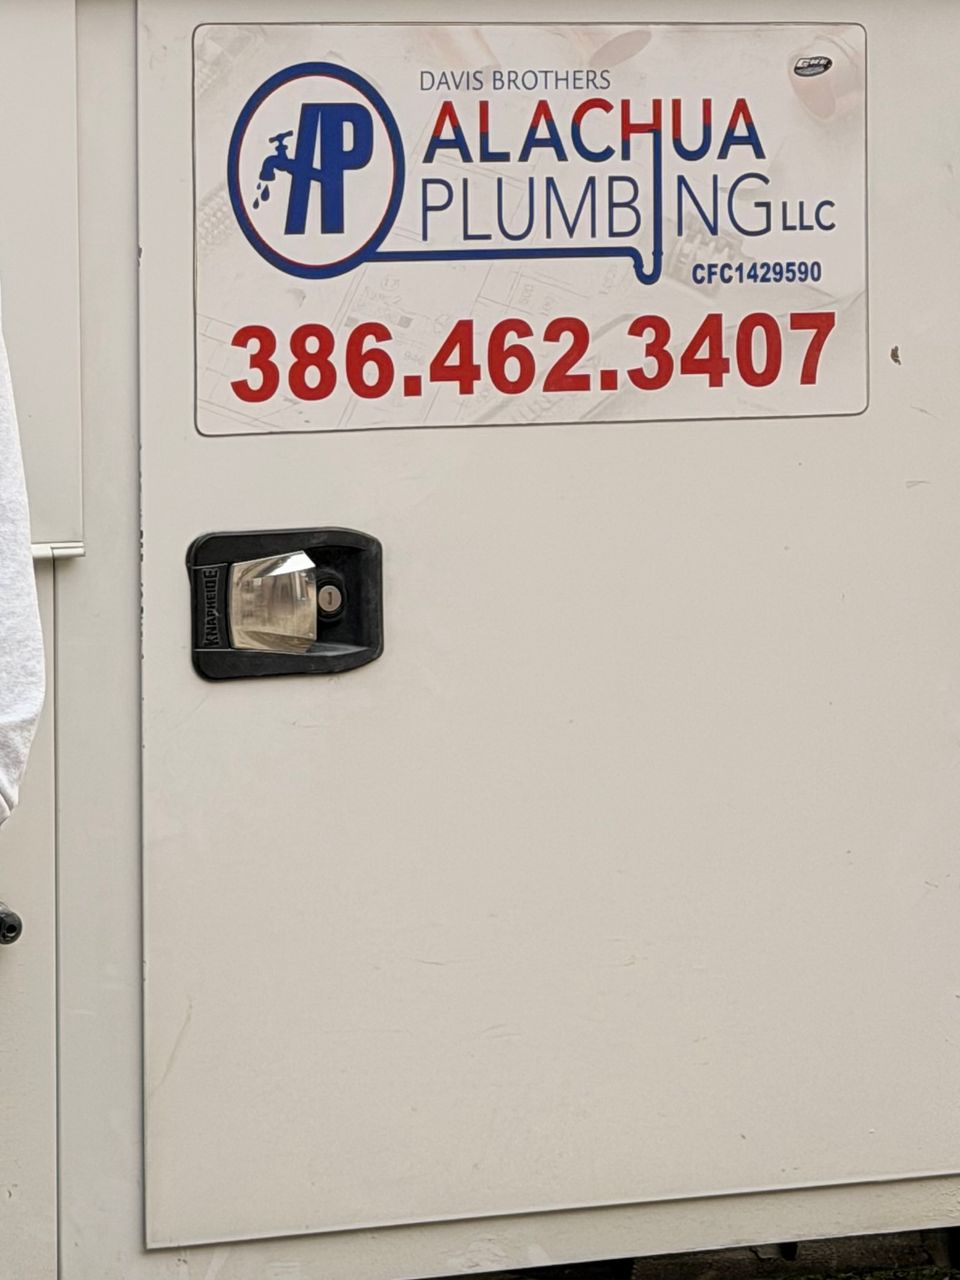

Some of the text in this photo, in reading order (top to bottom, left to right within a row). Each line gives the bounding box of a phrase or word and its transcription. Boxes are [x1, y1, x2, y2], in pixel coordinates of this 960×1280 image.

[420, 69, 611, 91] DAVIS BROTHERS
[422, 97, 767, 164] ALACHUA
[283, 102, 374, 235] AP
[421, 172, 837, 242] PLUMBING LLC
[691, 260, 823, 285] CFC1429590
[229, 311, 837, 404] 386.462.3407
[202, 568, 220, 648] KNAPHEIDE
